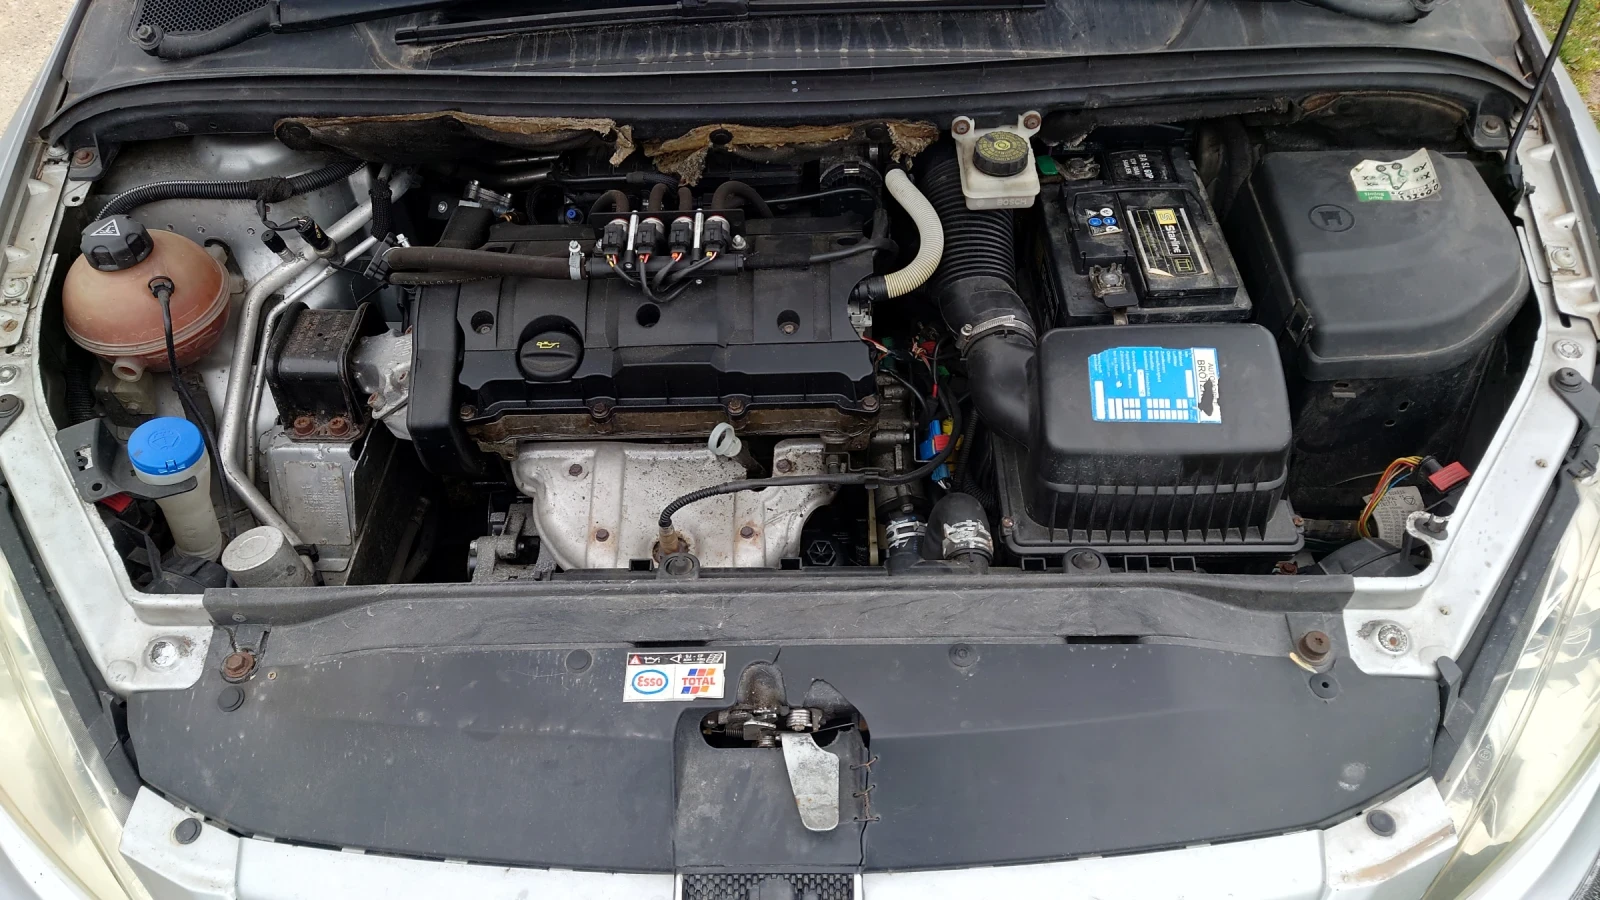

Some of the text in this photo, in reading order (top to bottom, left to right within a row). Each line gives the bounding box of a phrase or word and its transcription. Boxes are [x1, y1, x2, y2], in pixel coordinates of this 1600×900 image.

[997, 198, 1027, 206] BOSCH
[1164, 225, 1182, 253] Starline
[681, 677, 716, 686] TOTAL
